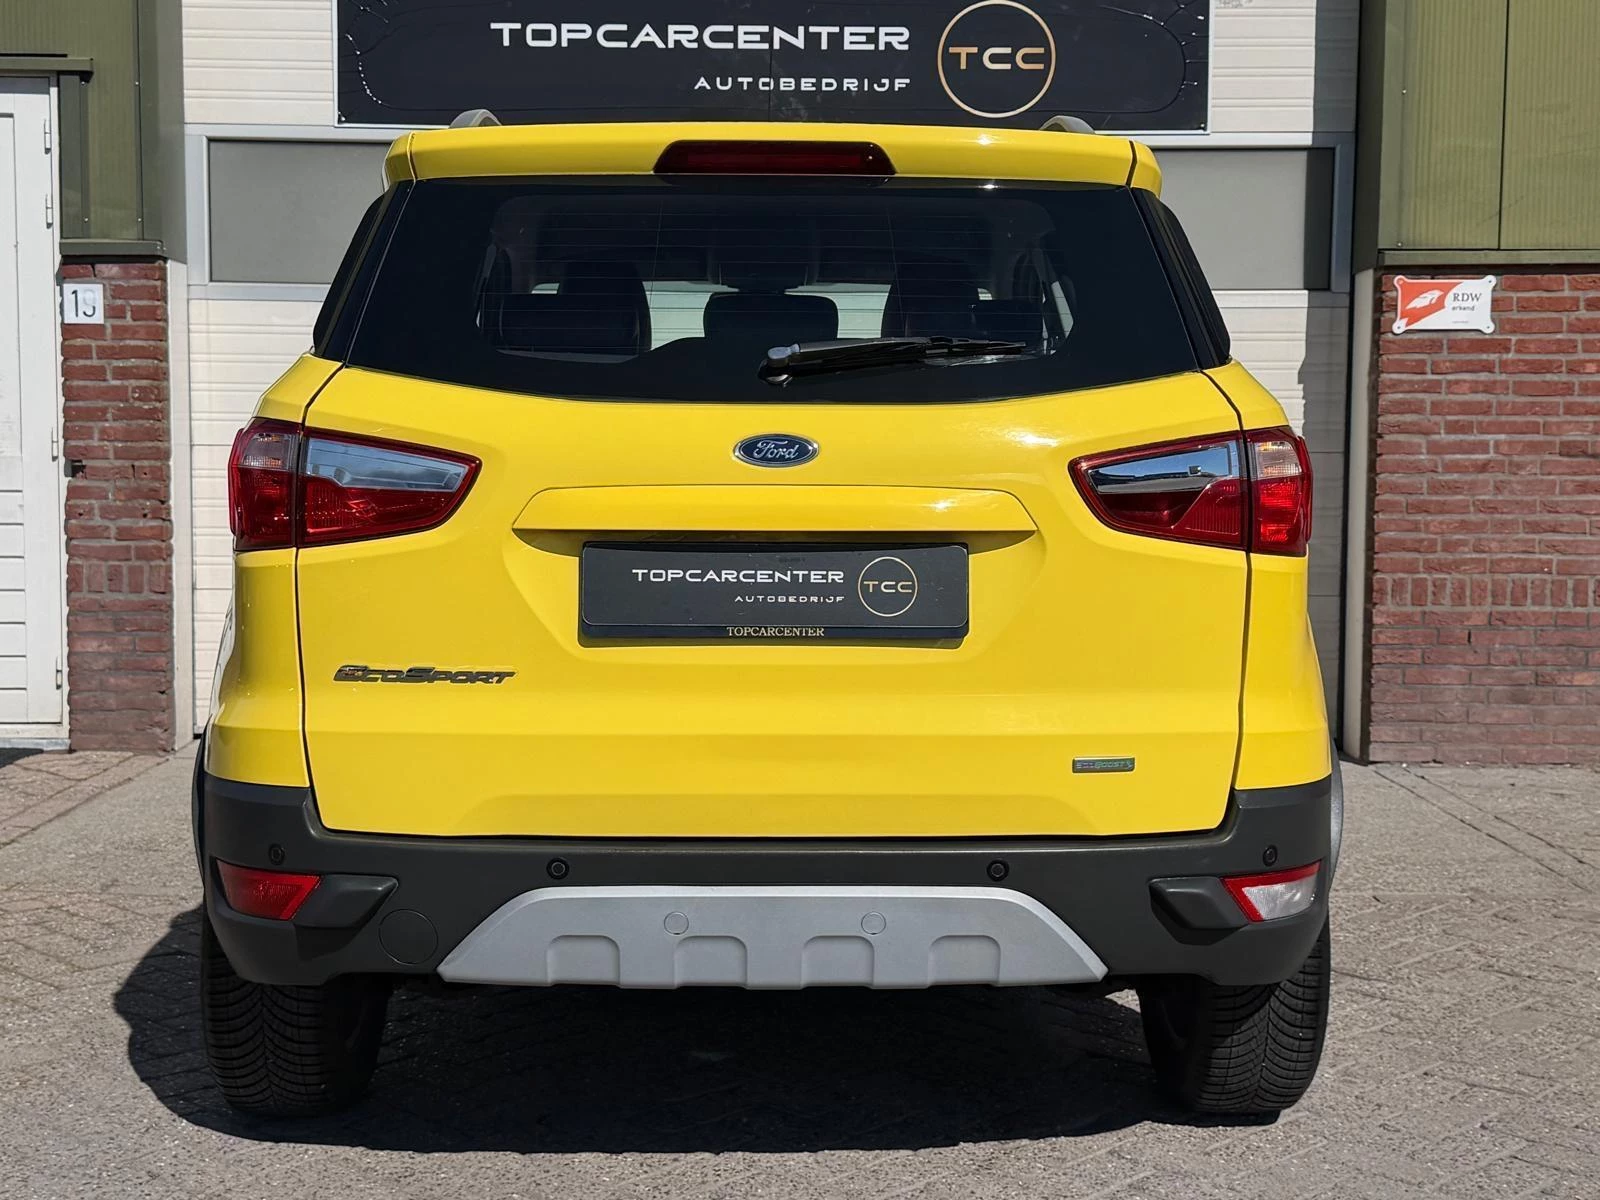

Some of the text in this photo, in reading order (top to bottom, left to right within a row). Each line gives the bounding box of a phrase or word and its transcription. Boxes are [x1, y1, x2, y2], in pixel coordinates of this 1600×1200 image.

[490, 22, 910, 51] TOPCARCENTER
[948, 46, 1045, 70] TCC
[694, 76, 910, 92] AUTOBEDRIJF
[1452, 292, 1483, 302] RDW
[753, 439, 800, 460] Ford
[631, 569, 845, 584] TOPCARCENTER
[863, 580, 913, 593] TCC
[734, 595, 845, 604] AUTOBEDRIJF
[726, 626, 825, 638] TOPCARCENTER
